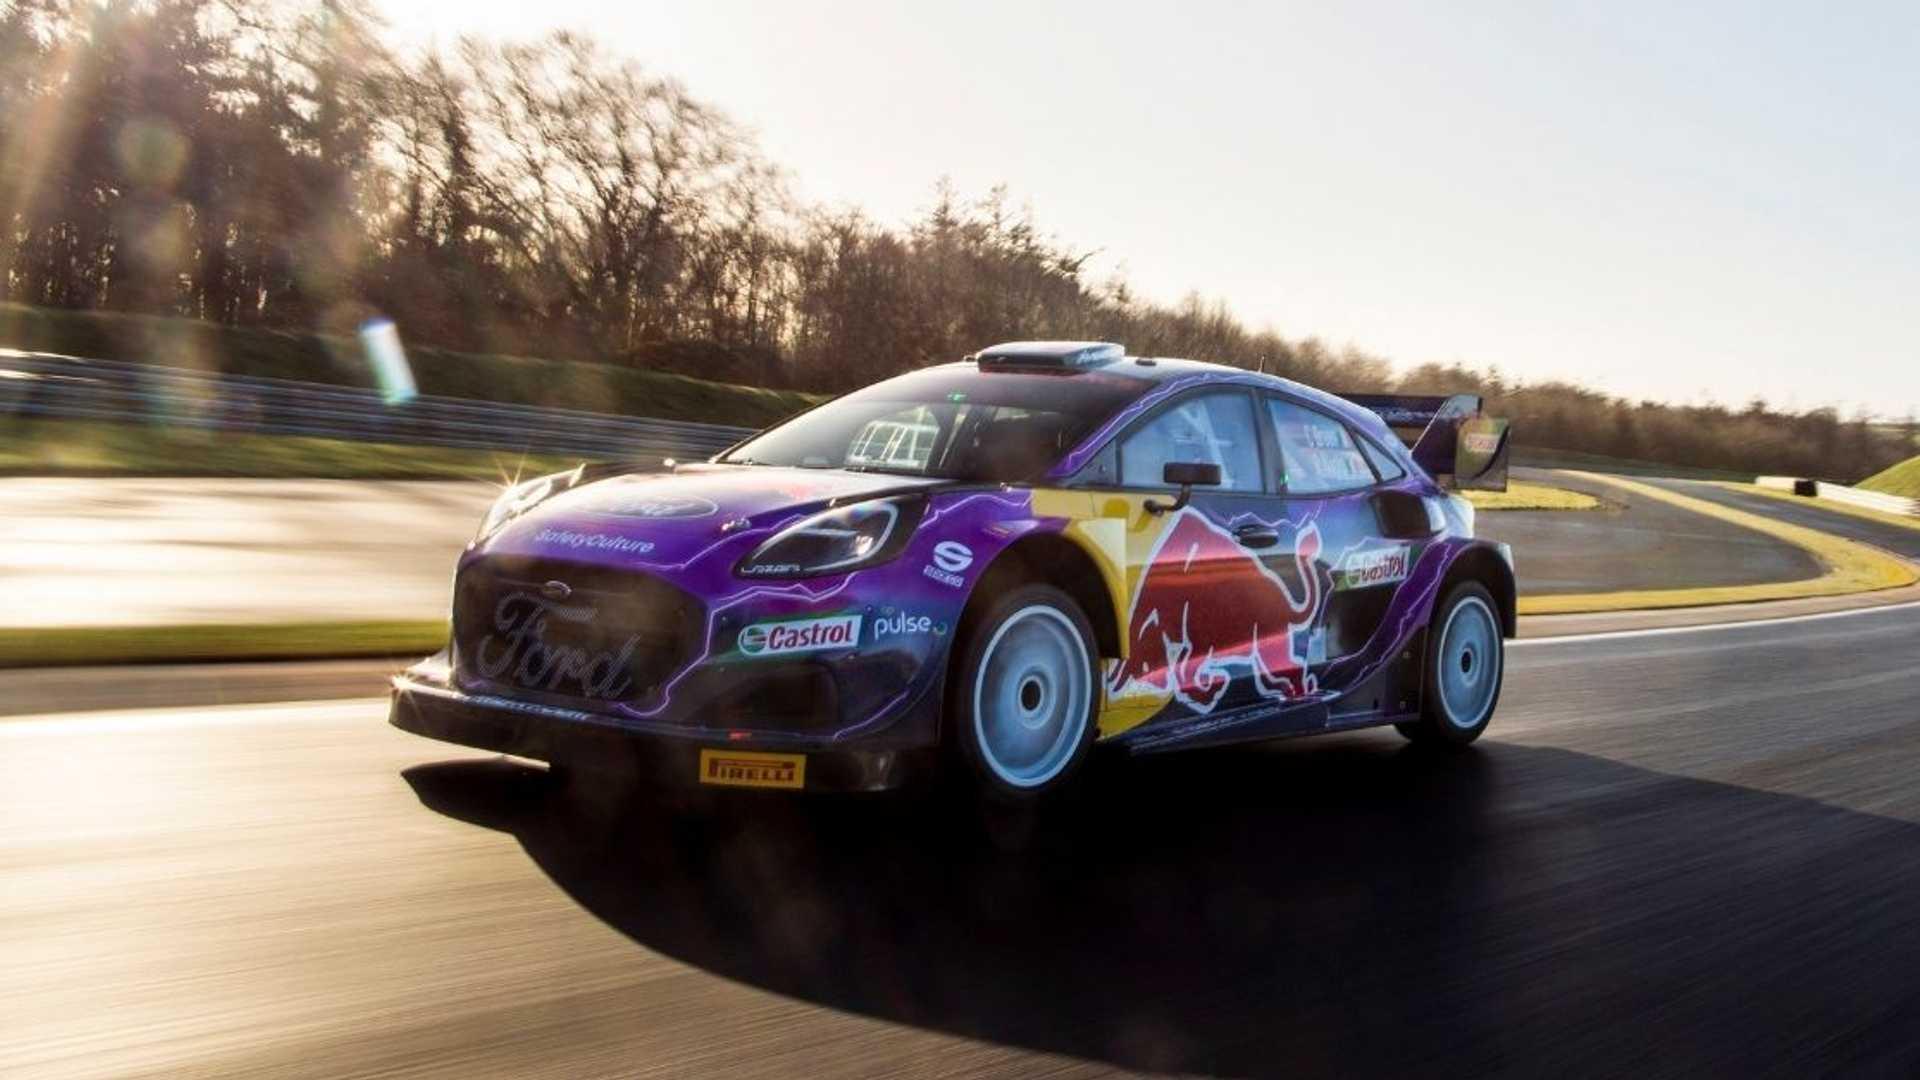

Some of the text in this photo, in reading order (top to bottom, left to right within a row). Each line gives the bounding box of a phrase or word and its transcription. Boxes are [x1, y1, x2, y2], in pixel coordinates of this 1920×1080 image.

[768, 620, 854, 650] Castrol
[873, 610, 932, 641] pulse
[477, 591, 642, 698] Ford
[707, 758, 796, 782] PIRELLI
